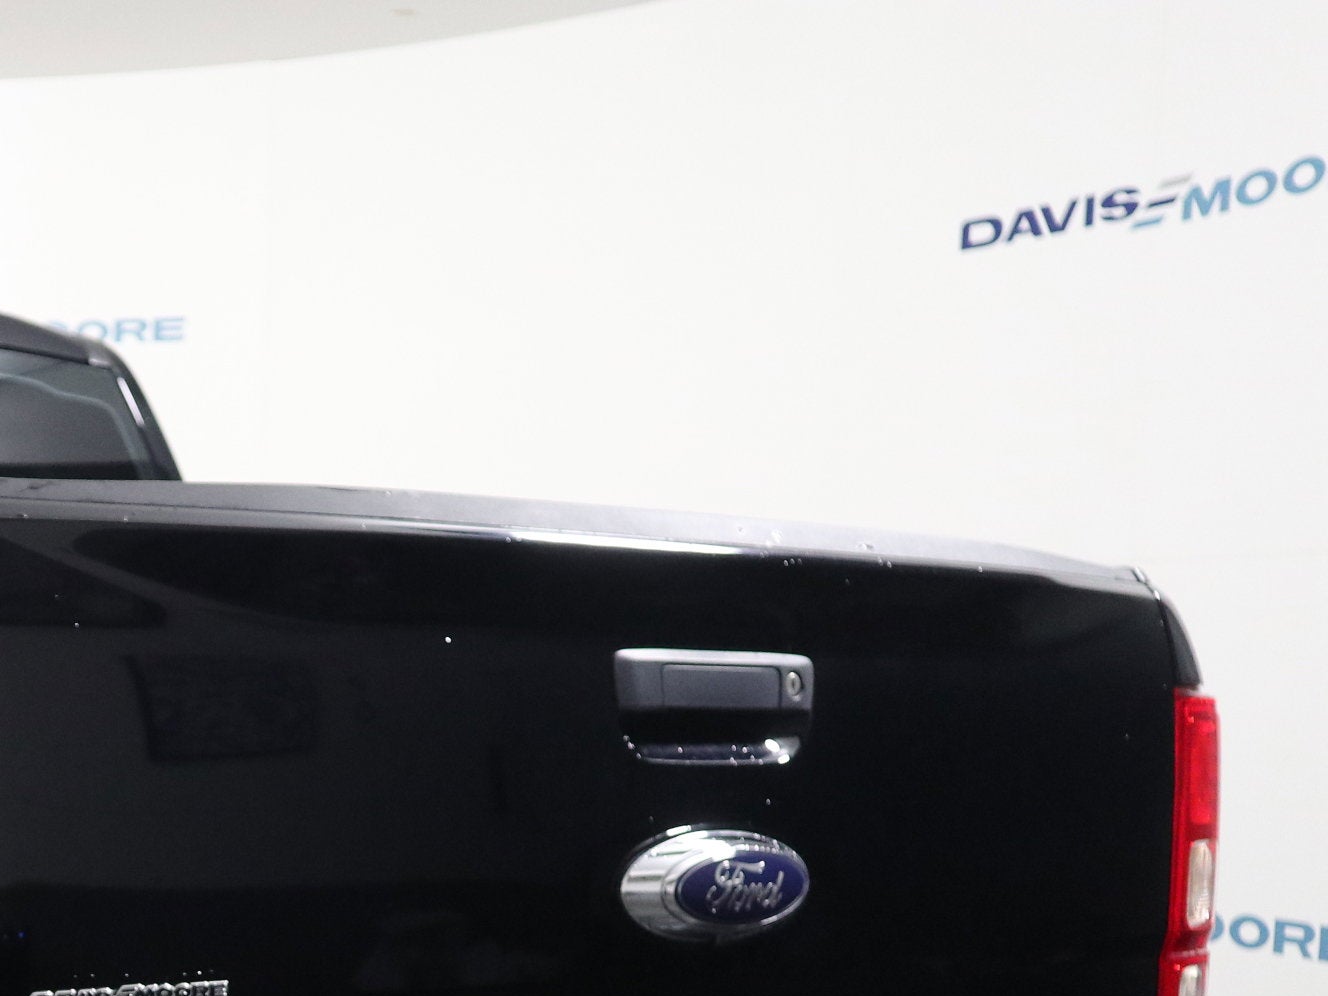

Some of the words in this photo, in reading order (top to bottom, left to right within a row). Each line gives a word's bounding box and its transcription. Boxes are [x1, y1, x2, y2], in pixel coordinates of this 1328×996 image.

[960, 187, 1140, 250] DAVIS
[1180, 155, 1327, 221] MOO
[48, 316, 185, 343] ORE
[705, 859, 785, 915] Ford
